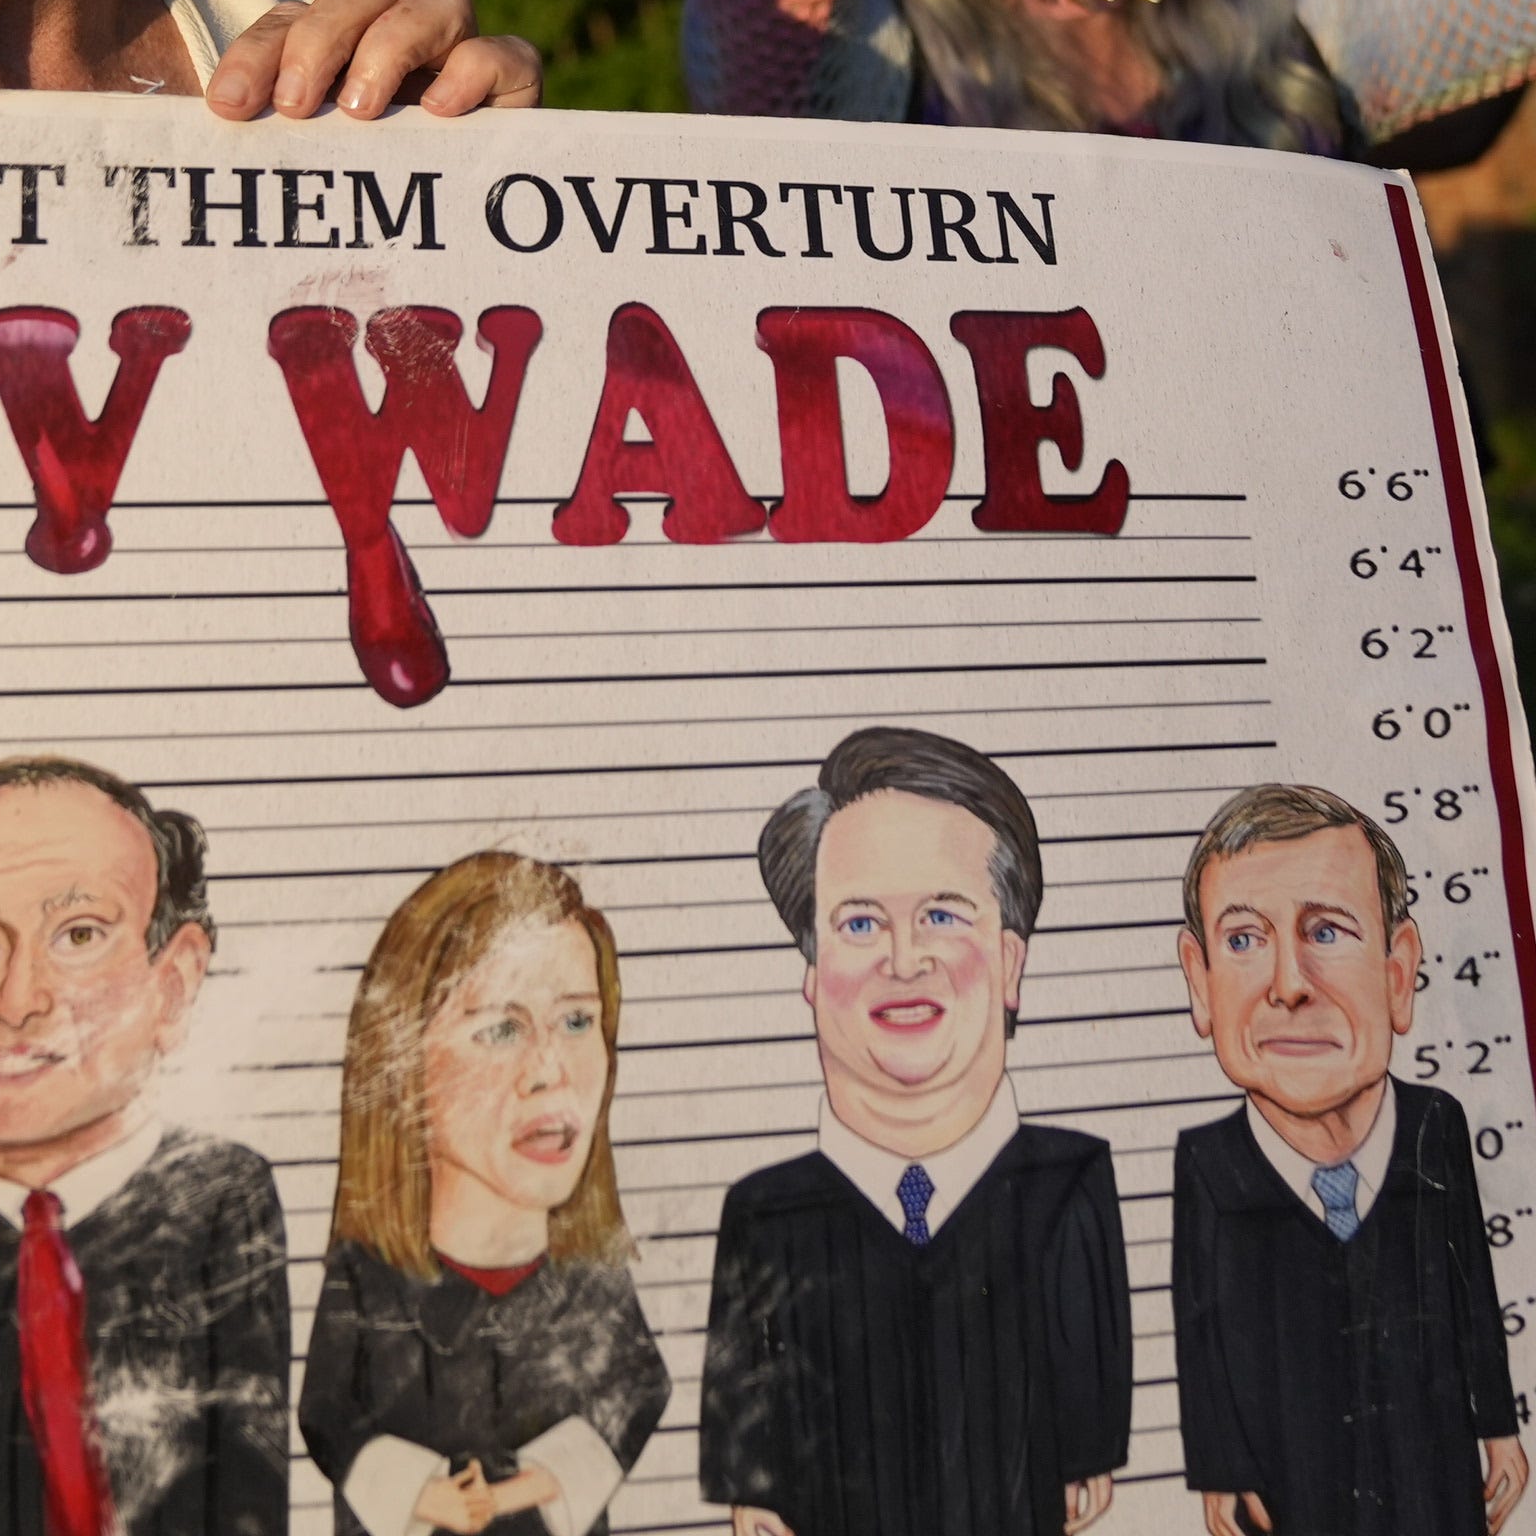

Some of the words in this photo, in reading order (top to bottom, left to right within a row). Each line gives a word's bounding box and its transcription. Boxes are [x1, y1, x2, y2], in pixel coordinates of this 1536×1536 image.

[104, 165, 446, 251] THEM
[485, 173, 1057, 265] OVERTURN
[268, 302, 1131, 547] WADE
